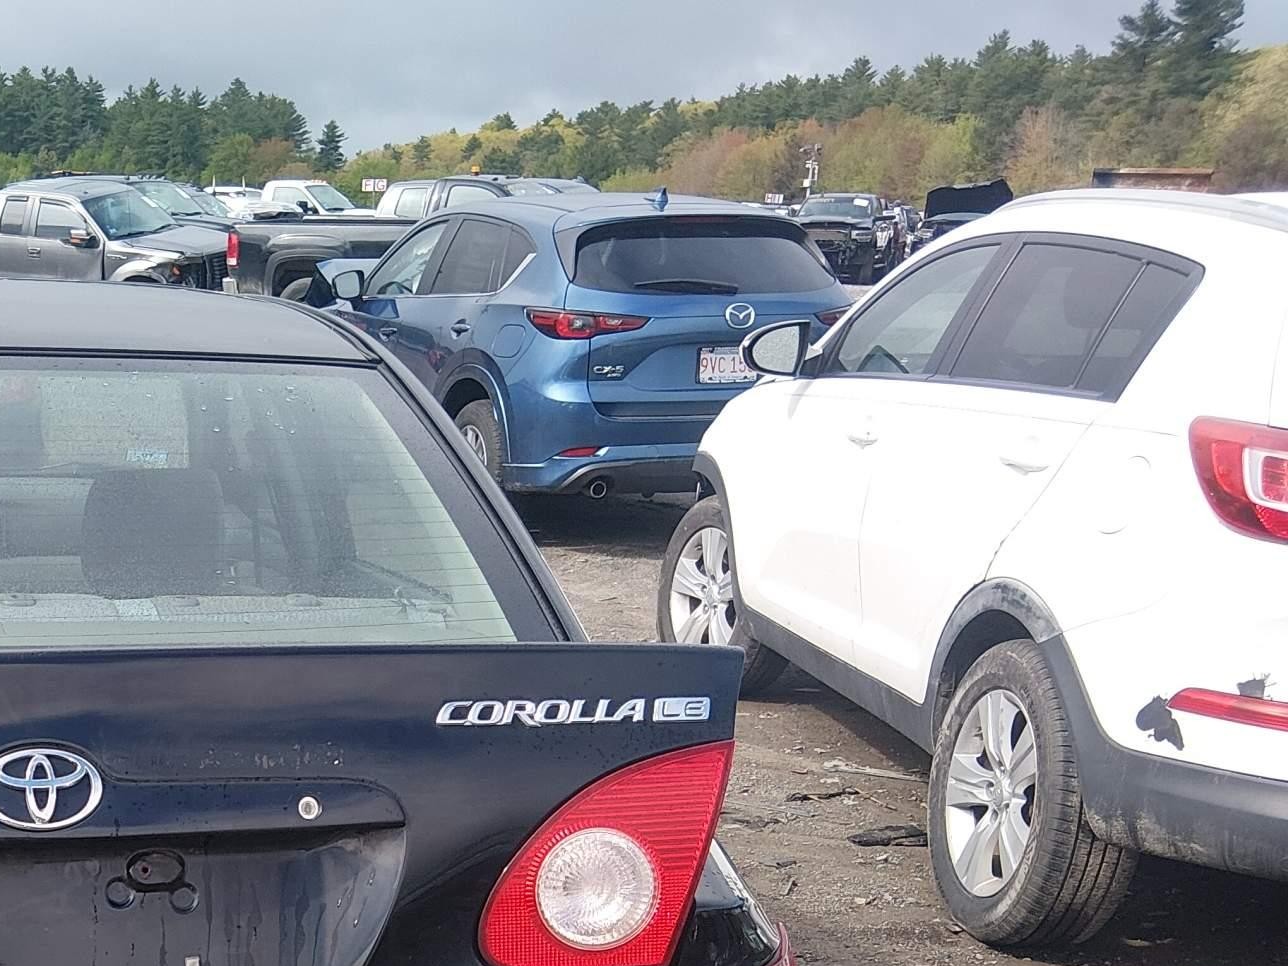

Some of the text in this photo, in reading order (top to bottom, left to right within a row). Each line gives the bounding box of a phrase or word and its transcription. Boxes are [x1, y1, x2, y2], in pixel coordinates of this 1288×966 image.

[364, 180, 385, 191] F G
[593, 365, 625, 374] CX-5
[701, 356, 753, 374] 9VC 15
[436, 697, 711, 727] COROLLA LE
